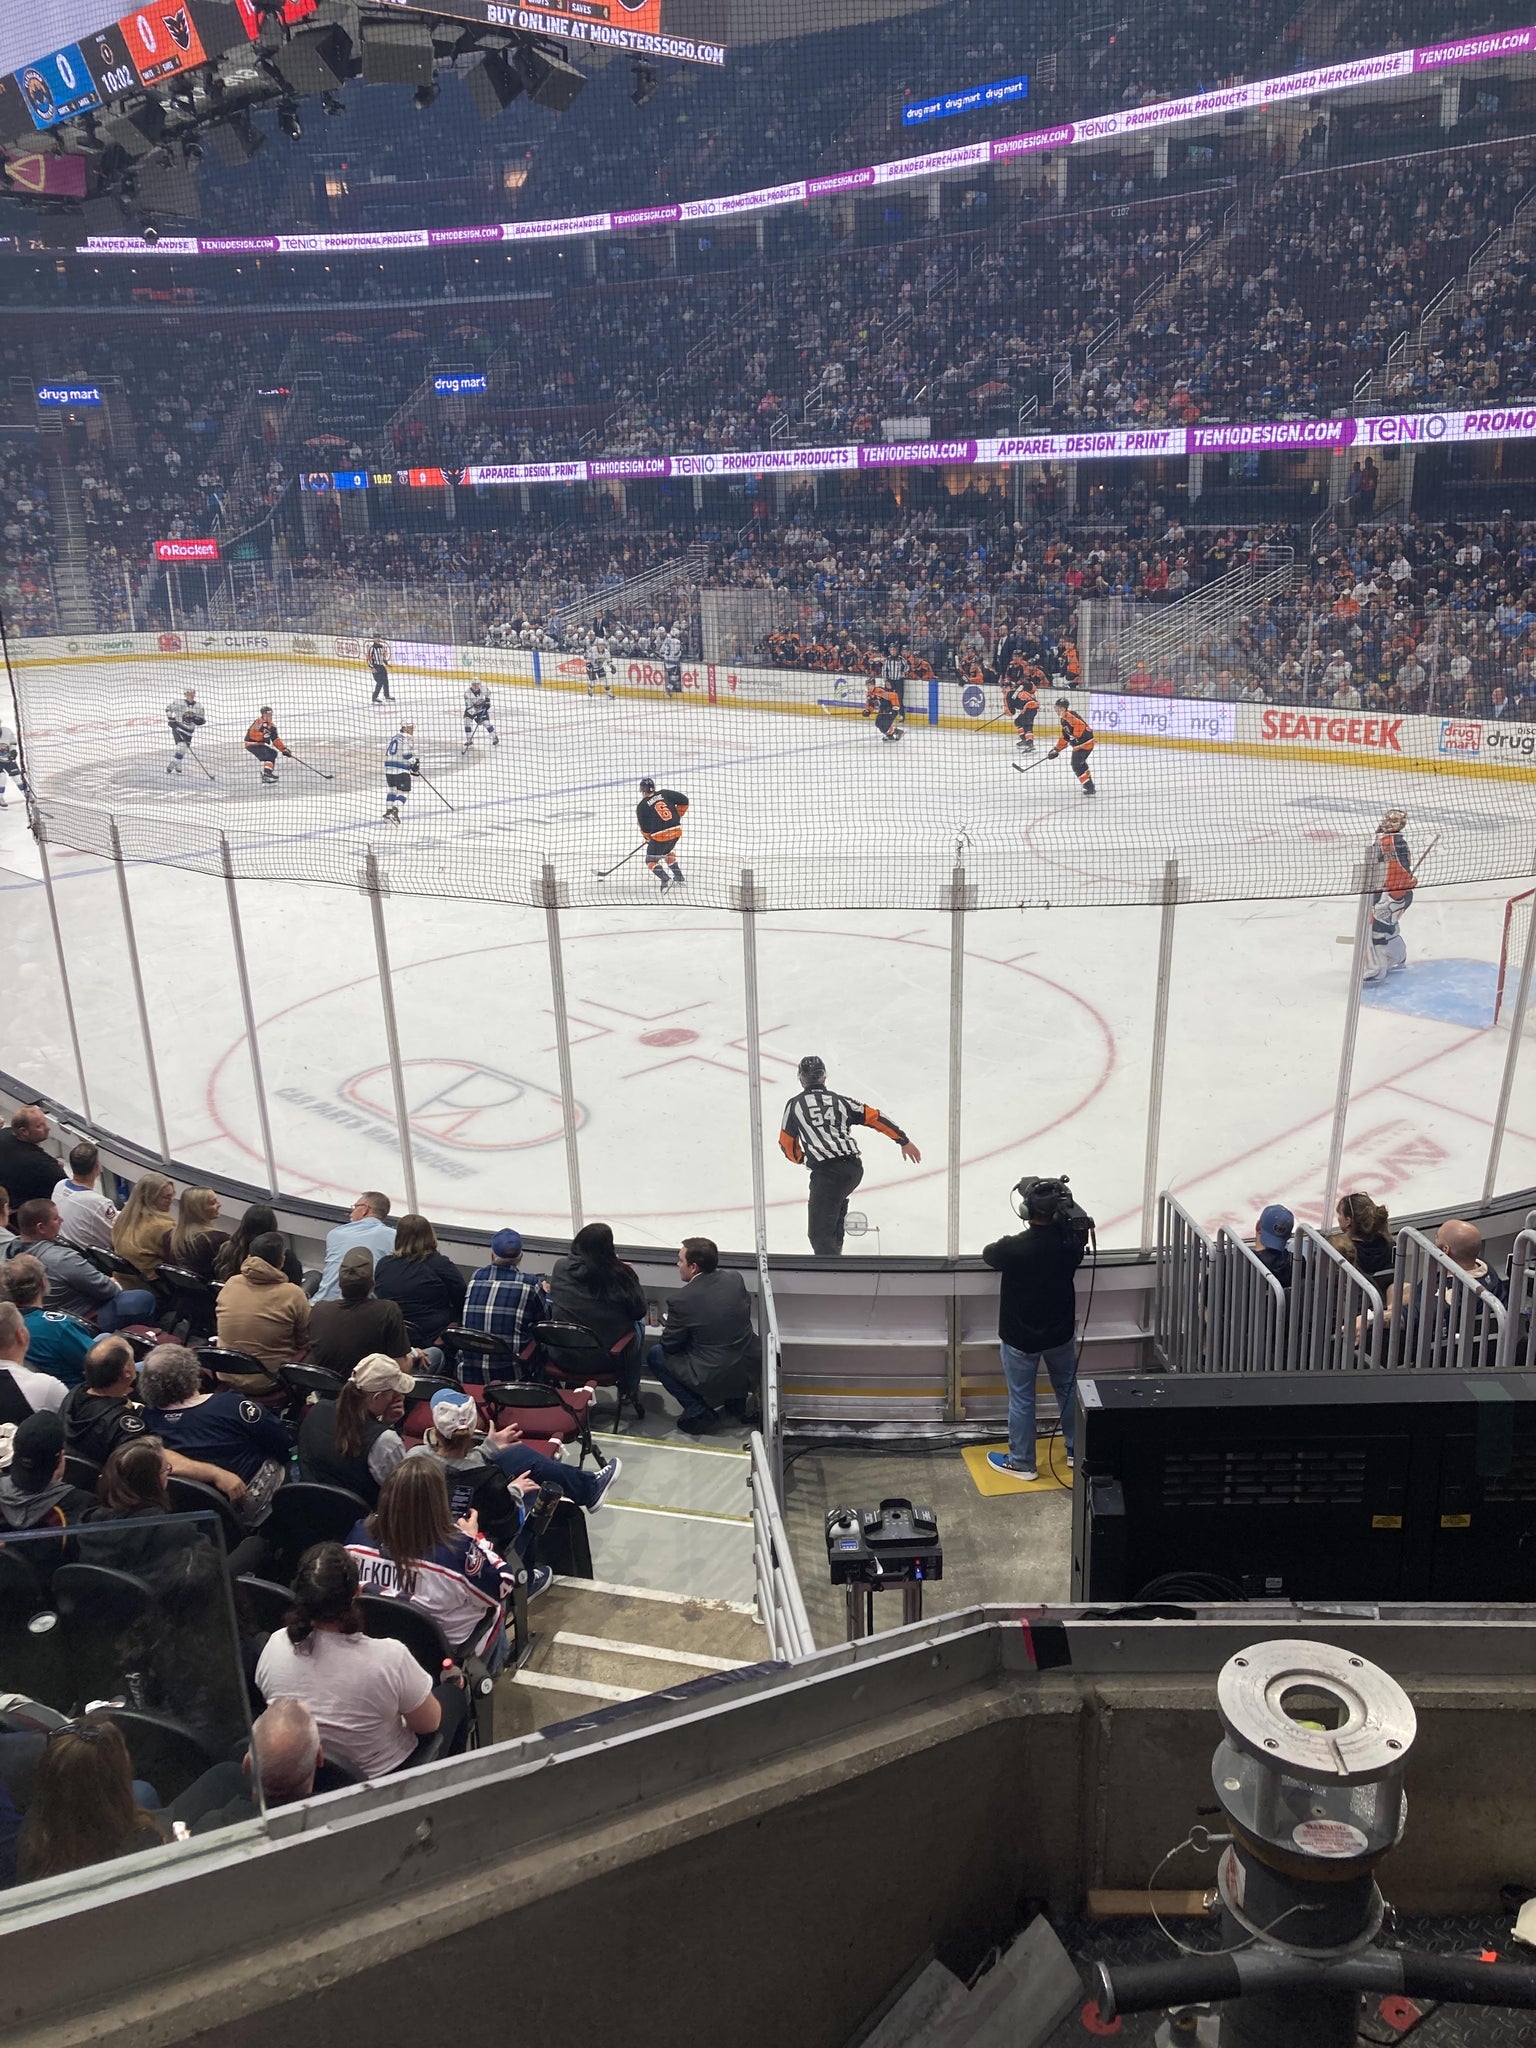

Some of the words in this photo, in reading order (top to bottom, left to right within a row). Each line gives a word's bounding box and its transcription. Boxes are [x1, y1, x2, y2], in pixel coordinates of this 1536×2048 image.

[571, 3, 592, 15] SAVES
[136, 14, 157, 53] 0
[487, 5, 517, 26] BUY
[518, 11, 569, 35] ONLINE
[571, 22, 588, 38] AT
[590, 26, 725, 64] MONSTERS5050.COM
[56, 53, 76, 89] 0
[101, 65, 134, 94] 10:02
[906, 107, 923, 119] drug
[924, 102, 941, 114] mart
[945, 98, 963, 110] drug
[963, 92, 981, 105] mart
[985, 87, 1003, 100] drug
[1004, 81, 1023, 94] mart
[325, 236, 382, 246] PROMOTIONAL
[383, 234, 423, 245] PRODUCTS
[516, 223, 551, 235] BRANDED
[553, 218, 605, 231] MERCHANDISE
[767, 187, 800, 202] PRODUCTS
[889, 161, 924, 176] BRANDED
[925, 149, 981, 169] MERCHANDISE
[1125, 103, 1193, 126] PROMOTIONAL
[1194, 91, 1248, 111] PRODUCTS
[1264, 77, 1316, 96] BRANDED
[1317, 58, 1401, 86] MERCHANDISE
[1419, 33, 1531, 65] TEN10DESIGN.COM
[39, 388, 69, 403] drug
[70, 389, 99, 400] mart
[435, 378, 459, 391] drug
[460, 376, 487, 388] mart
[590, 460, 665, 475] TEN10DESIGN.COM
[722, 453, 792, 469] PROMOTIONAL
[793, 450, 849, 466] PRODUCTS
[862, 443, 968, 462] TEN10DESIGN.COM
[1126, 432, 1170, 449] PRINT
[1194, 422, 1342, 446] TEN10DESIGN.COM
[373, 474, 392, 484] 10:02
[171, 544, 215, 556] Rocket
[224, 636, 269, 648] CLIFFS
[643, 663, 700, 689] Roet
[1092, 709, 1118, 728] nrg
[1141, 713, 1168, 732] nrg
[1191, 717, 1219, 736] nrg
[1262, 709, 1405, 752] SEATGEEK
[1444, 722, 1474, 741] drug
[1445, 739, 1480, 750] mart
[1487, 731, 1535, 755] drug
[654, 801, 673, 821] 6
[808, 1106, 836, 1127] 54
